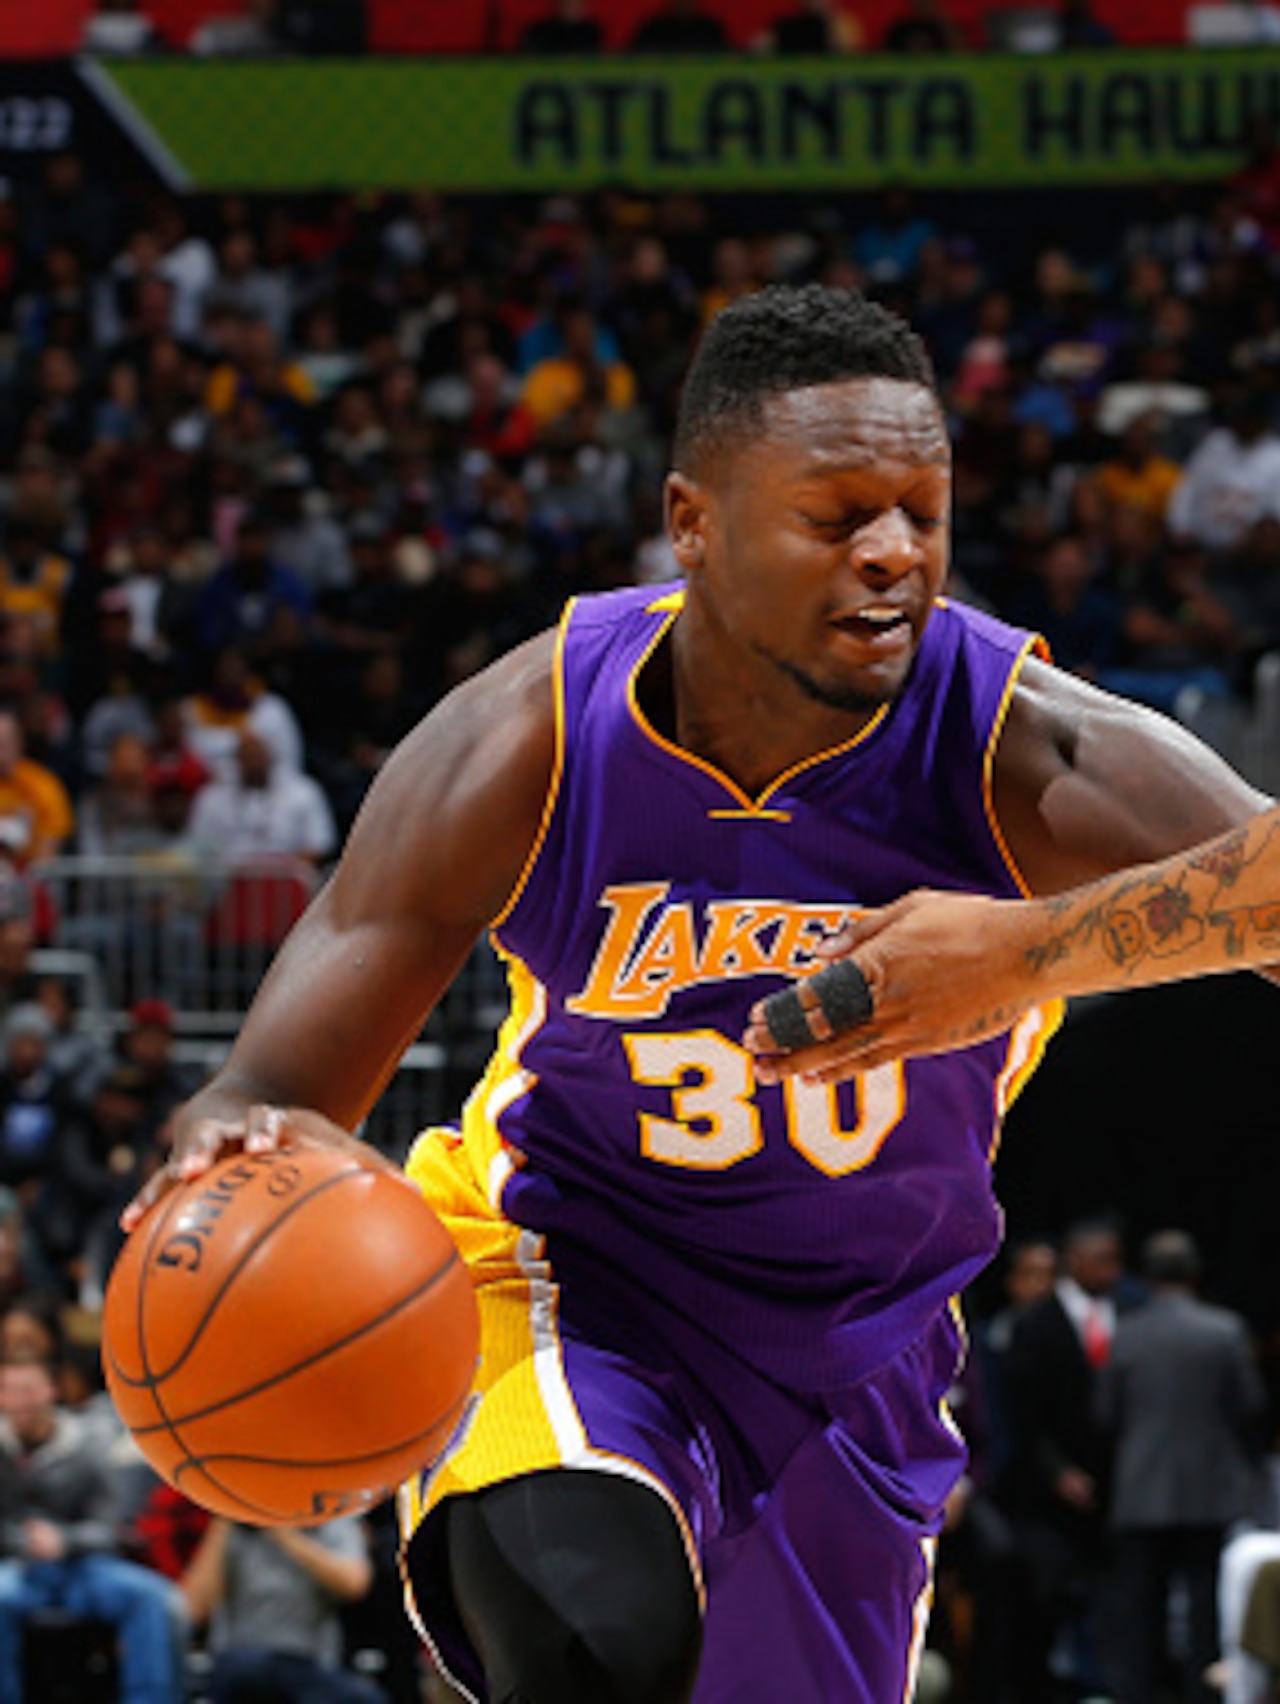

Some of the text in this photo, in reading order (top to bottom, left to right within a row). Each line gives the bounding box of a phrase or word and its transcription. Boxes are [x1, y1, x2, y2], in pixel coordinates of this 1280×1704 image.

[0, 97, 72, 148] 22
[516, 75, 978, 166] ATLANTA
[564, 880, 888, 1020] LAKE
[621, 1027, 908, 1178] 30
